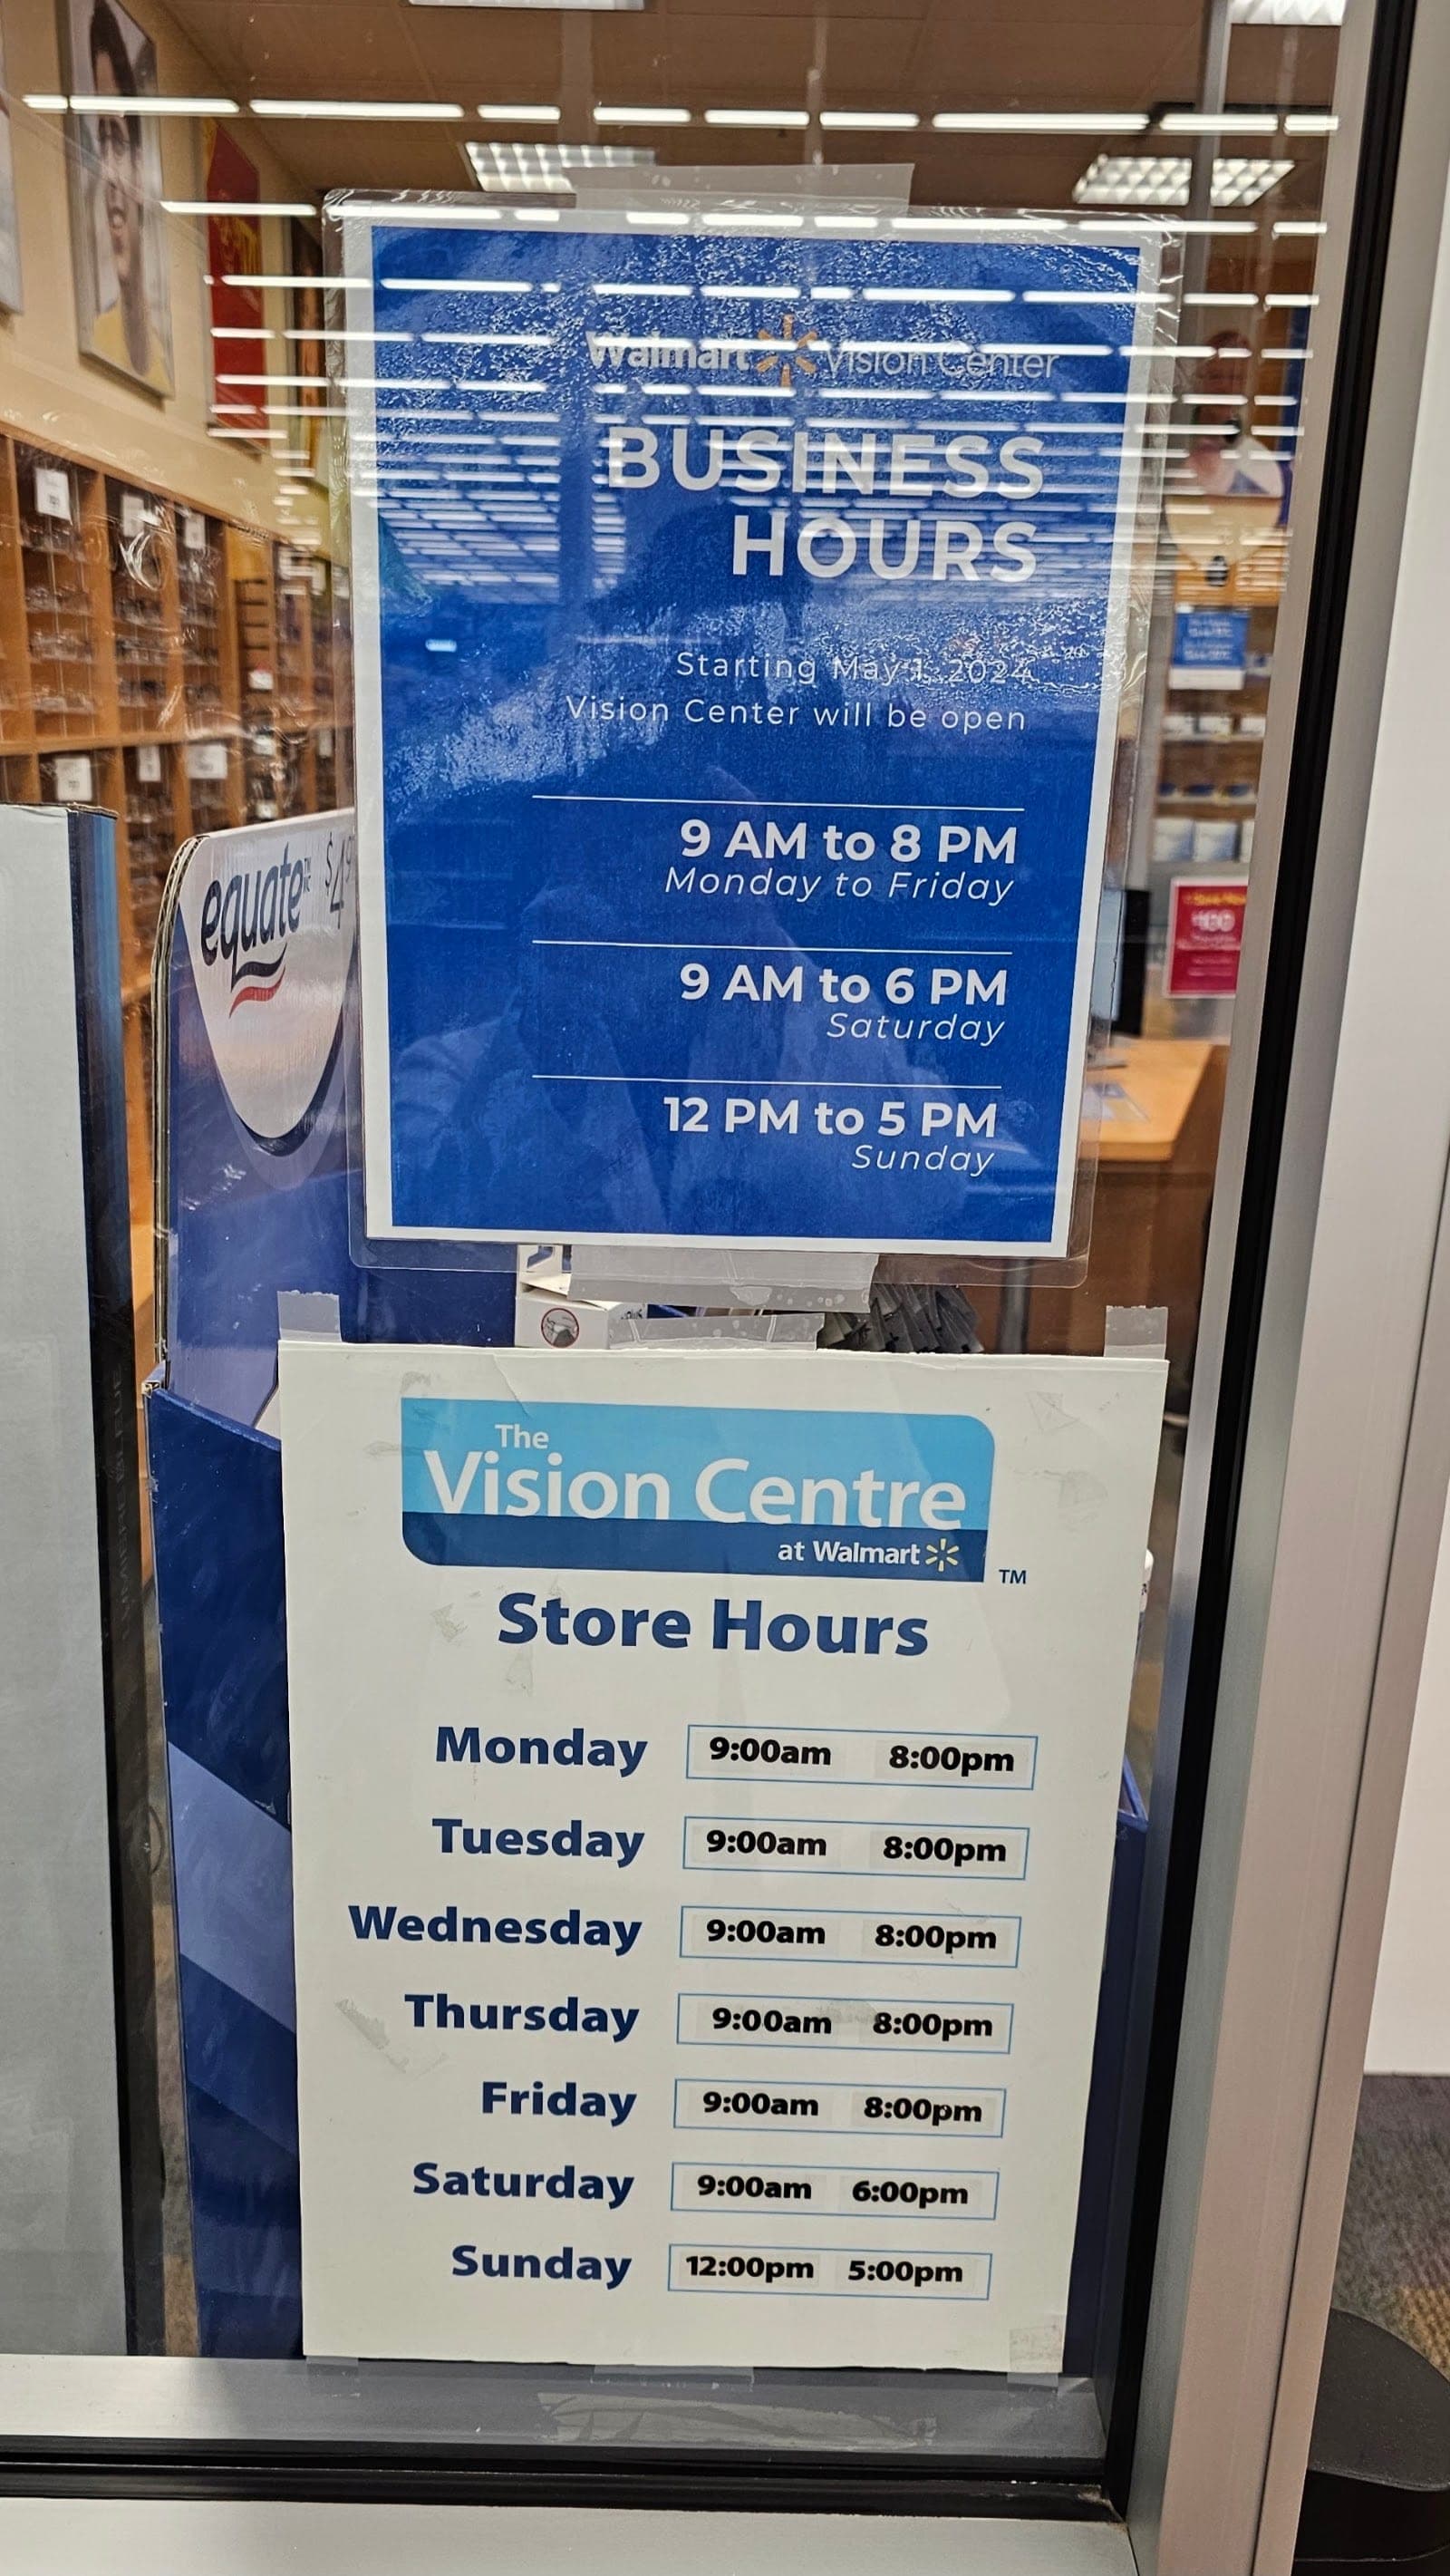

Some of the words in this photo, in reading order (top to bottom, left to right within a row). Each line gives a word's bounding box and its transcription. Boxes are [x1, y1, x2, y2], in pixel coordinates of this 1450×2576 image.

[607, 426, 1044, 499] BUSINESS
[732, 515, 1038, 583] HOURS
[676, 652, 816, 684] Starting
[833, 658, 900, 686] May
[566, 695, 668, 721] Vision
[684, 699, 799, 725] Center
[814, 702, 871, 727] will
[888, 702, 927, 729] be
[942, 710, 1025, 735] open
[680, 818, 711, 858] 9
[724, 821, 807, 860] AM
[823, 825, 875, 862] to
[890, 824, 922, 864] 8
[938, 826, 1017, 865] PM
[664, 867, 822, 903] Monday
[836, 873, 873, 897] to
[889, 871, 1015, 907] Friday
[201, 841, 304, 993] equate
[680, 963, 710, 1001] 9
[722, 965, 803, 1002] AM
[819, 969, 871, 1004] to
[885, 968, 914, 1005] 6
[931, 969, 1008, 1006] PM
[826, 1012, 1006, 1047] Saturday
[663, 1097, 709, 1133] 12
[725, 1099, 799, 1135] PM
[815, 1101, 865, 1137] to
[877, 1101, 905, 1137] 5
[921, 1102, 997, 1138] PM
[851, 1145, 995, 1177] Sunday
[495, 1423, 549, 1449] The
[422, 1449, 671, 1520] Vision
[694, 1457, 966, 1530] Centre
[778, 1542, 805, 1562] at
[813, 1541, 921, 1565] Walmart
[999, 1569, 1027, 1584] TM
[498, 1593, 691, 1649] Store
[712, 1599, 929, 1656] Hours
[436, 1726, 648, 1777] Monday
[709, 1737, 832, 1766] 9:00am
[889, 1745, 1014, 1777] 8:00pm
[432, 1817, 645, 1868] Tuesday
[705, 1829, 826, 1856] 9:00am
[883, 1835, 1007, 1867] 8:00pm
[348, 1905, 643, 1957] Wednesday
[706, 1919, 826, 1944] 9:00am
[875, 1924, 997, 1954] 8:00pm
[404, 1993, 640, 2043] Thursday
[711, 2007, 832, 2034] 9:00am
[873, 2011, 992, 2042] 8:00pm
[482, 2081, 637, 2127] Friday
[702, 2091, 819, 2116] 9:00am
[864, 2097, 982, 2126] 8:00pm
[413, 2162, 634, 2210] Saturday
[697, 2174, 812, 2200] 9:00am
[852, 2180, 969, 2209] 6:00pm
[451, 2245, 633, 2290] Sunday
[686, 2255, 814, 2283] 12:00pm
[847, 2260, 963, 2288] 5:00pm
